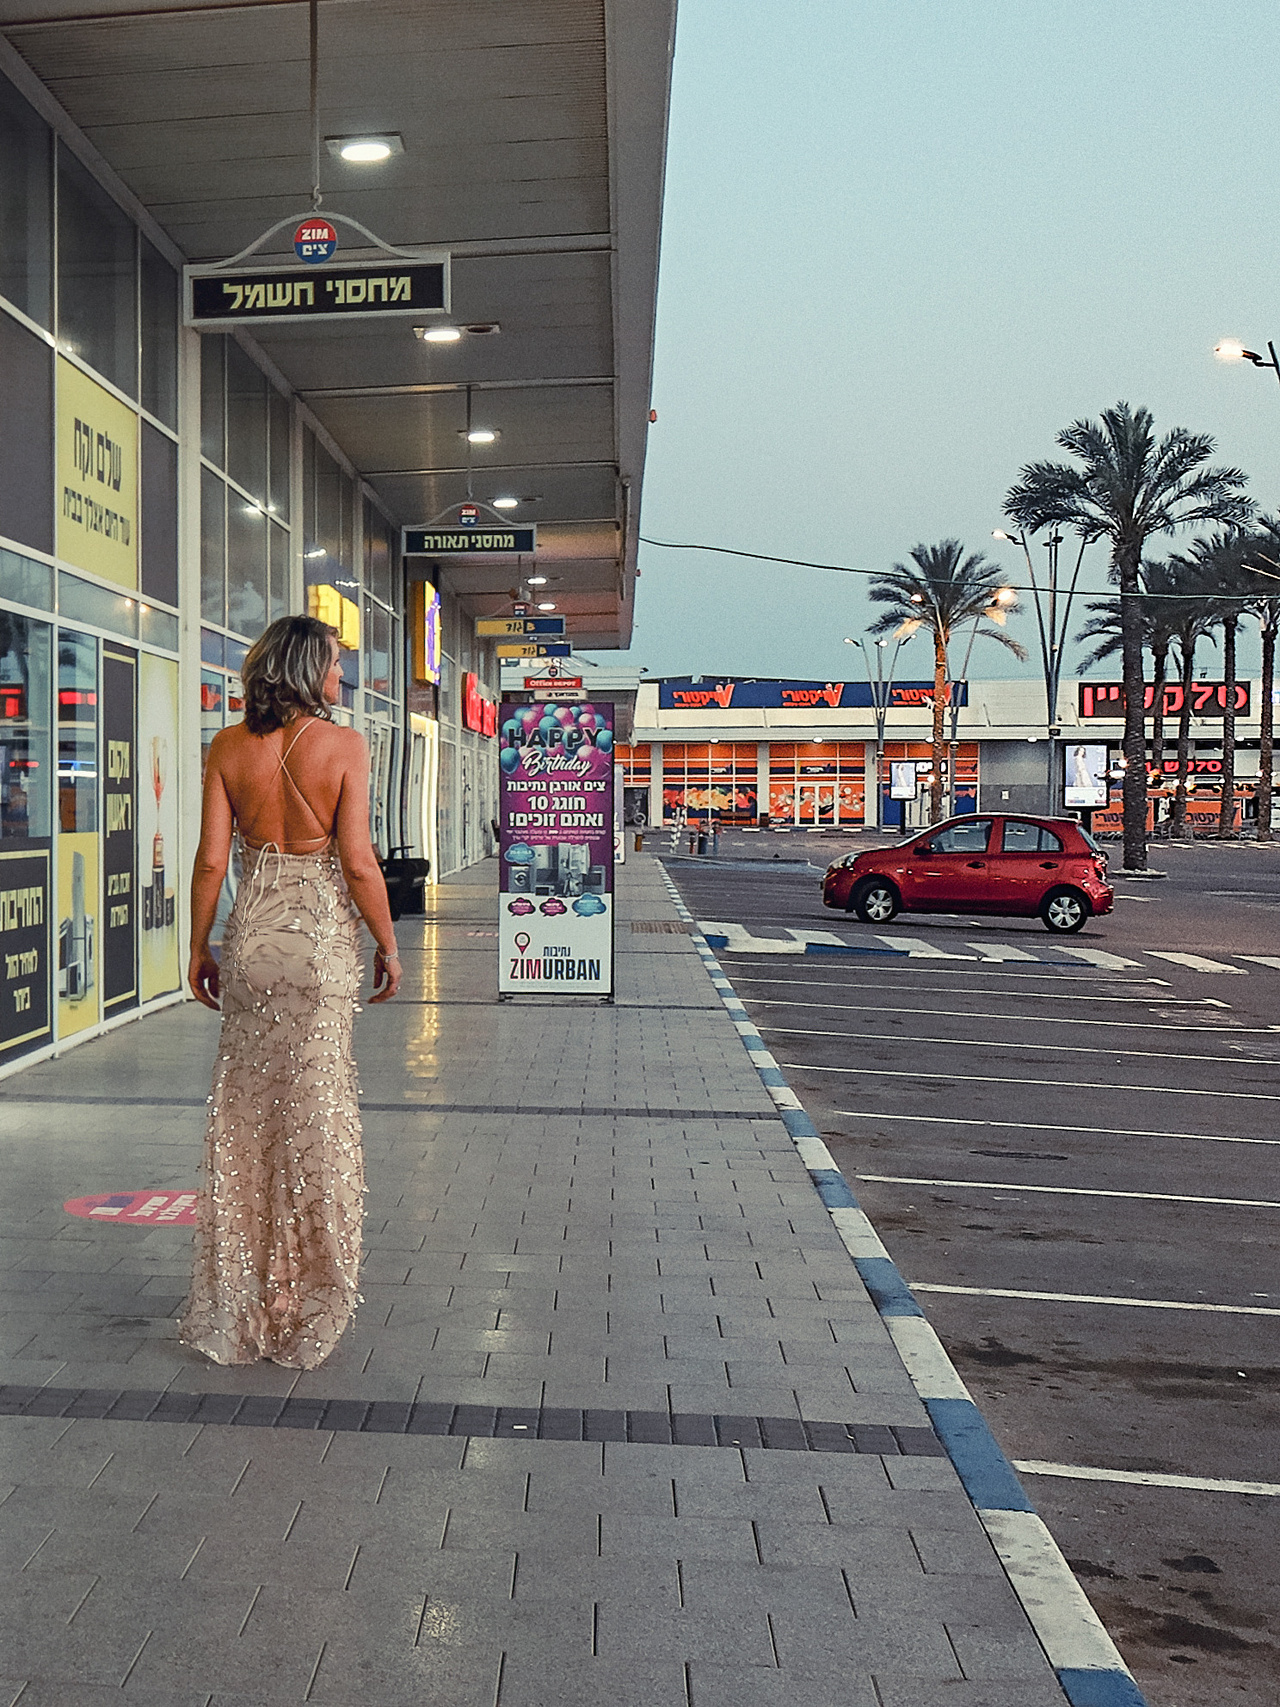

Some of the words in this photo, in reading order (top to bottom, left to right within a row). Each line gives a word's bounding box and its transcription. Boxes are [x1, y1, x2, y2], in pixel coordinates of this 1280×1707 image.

[301, 228, 329, 241] ZIM
[302, 243, 328, 257] צים
[222, 281, 315, 310] חשמל
[326, 275, 412, 304] מחסני
[74, 417, 94, 482] וקח
[96, 430, 122, 493] שלם
[63, 486, 83, 525] בבית
[424, 535, 469, 549] תאורה
[471, 534, 515, 548] מחסני
[508, 727, 605, 750] HAPPY
[521, 749, 592, 778] Birthday
[506, 780, 547, 792] נתיבות
[549, 780, 582, 795] אורבן
[583, 780, 607, 792] צים
[527, 795, 549, 811] 10
[551, 796, 586, 811] חוגג
[509, 812, 557, 828] זוכים!
[561, 813, 604, 828] ואתם
[542, 946, 572, 958] נתיבות
[509, 958, 601, 981] ZIMURBAN
